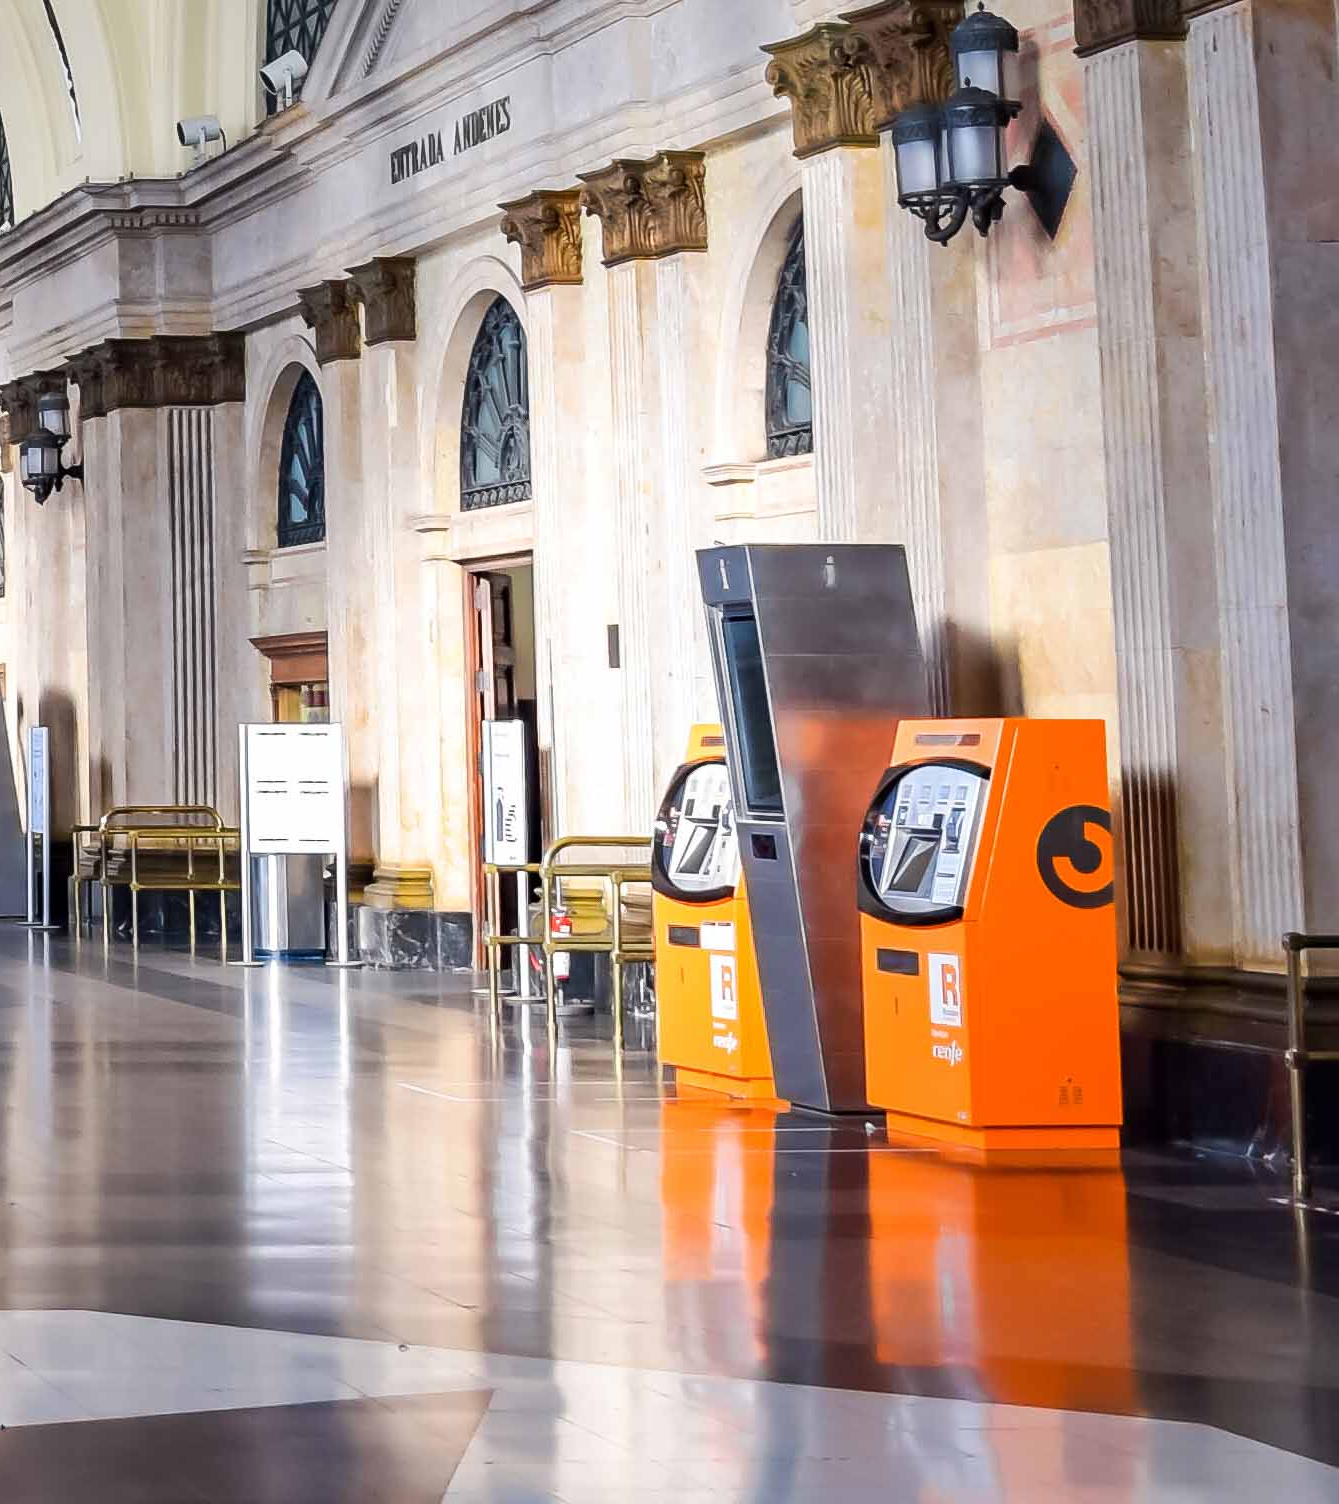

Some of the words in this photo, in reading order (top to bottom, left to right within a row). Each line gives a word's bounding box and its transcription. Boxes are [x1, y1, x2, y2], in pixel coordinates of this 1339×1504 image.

[390, 128, 444, 185] ENTRADA
[453, 95, 511, 156] ANDENES
[721, 965, 734, 1002] R
[941, 963, 959, 1006] R
[932, 1039, 964, 1067] renfe
